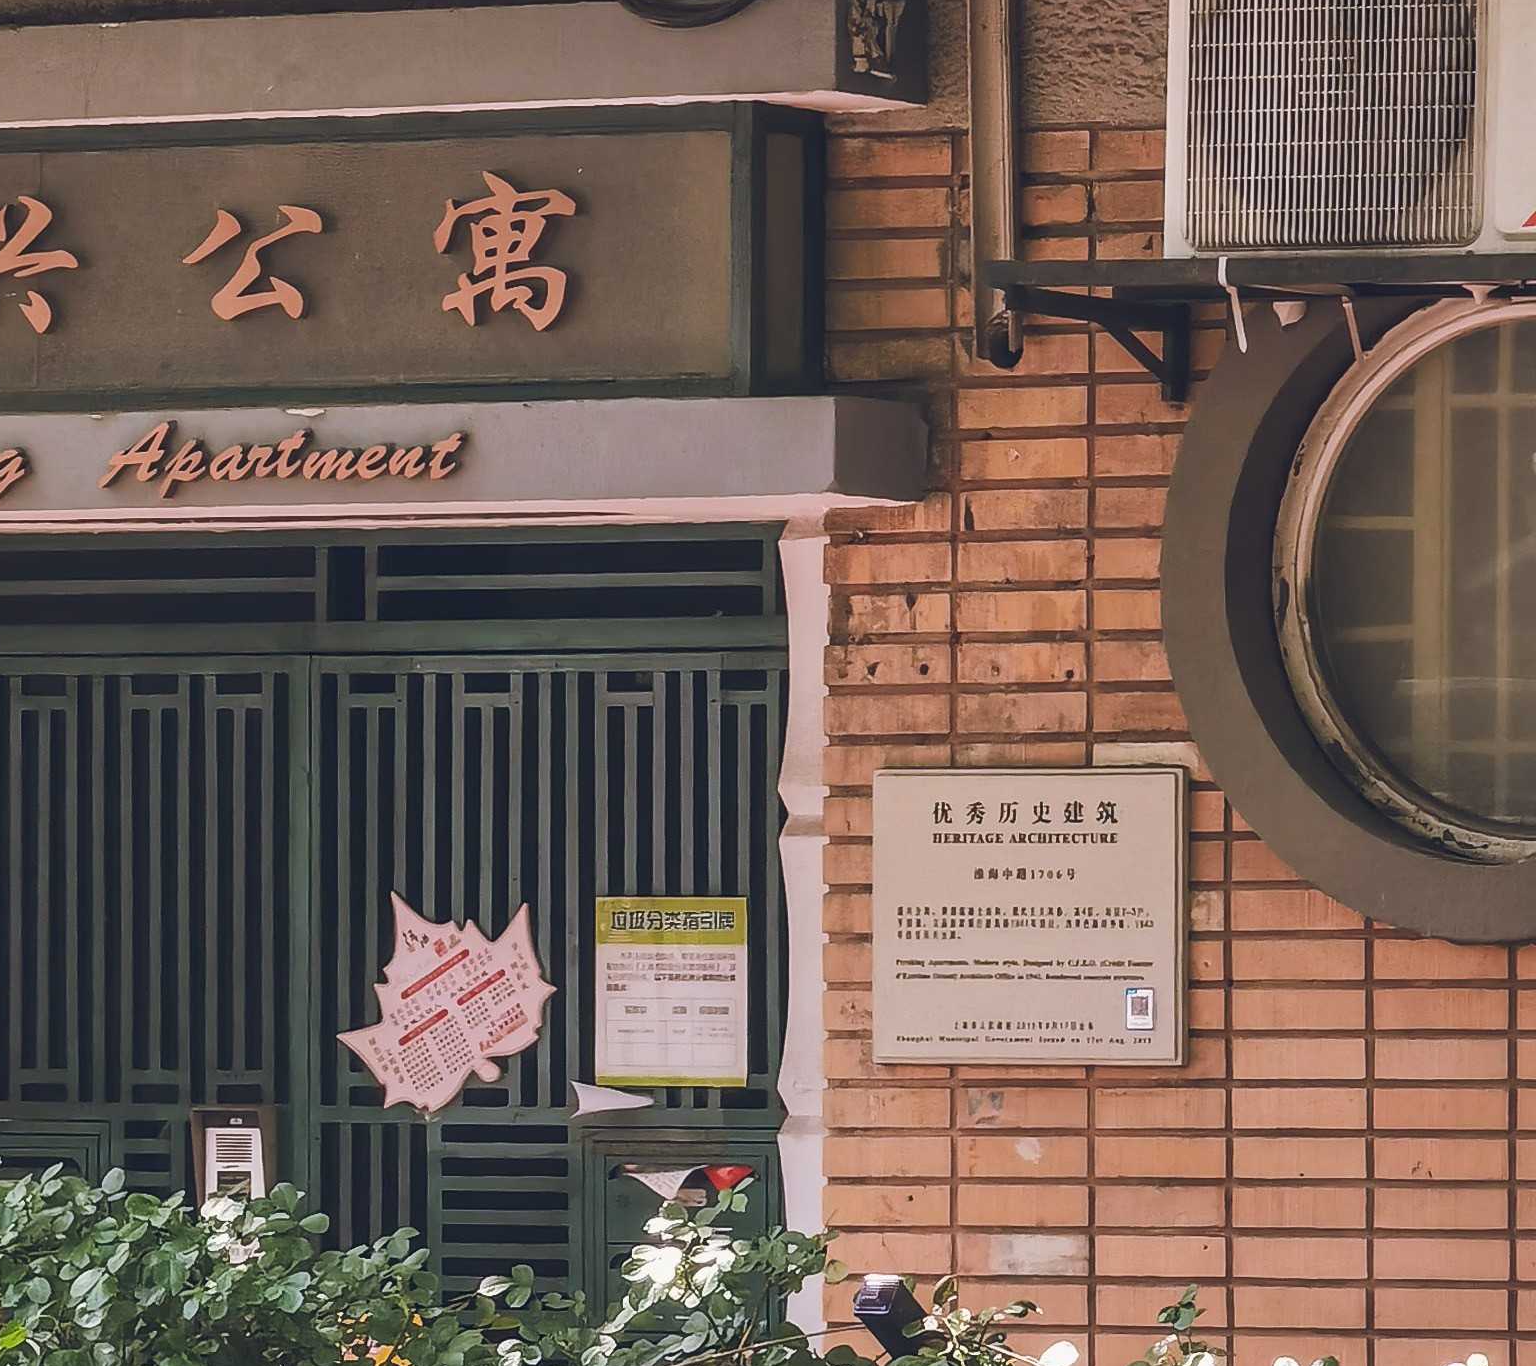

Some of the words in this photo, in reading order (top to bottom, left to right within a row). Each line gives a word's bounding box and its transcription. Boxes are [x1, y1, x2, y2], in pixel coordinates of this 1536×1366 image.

[97, 420, 465, 498] Apartment
[932, 800, 1119, 825] 优秀历史建筑
[932, 832, 1004, 844] HERITAGE
[1009, 832, 1119, 844] ARCHITECTURE
